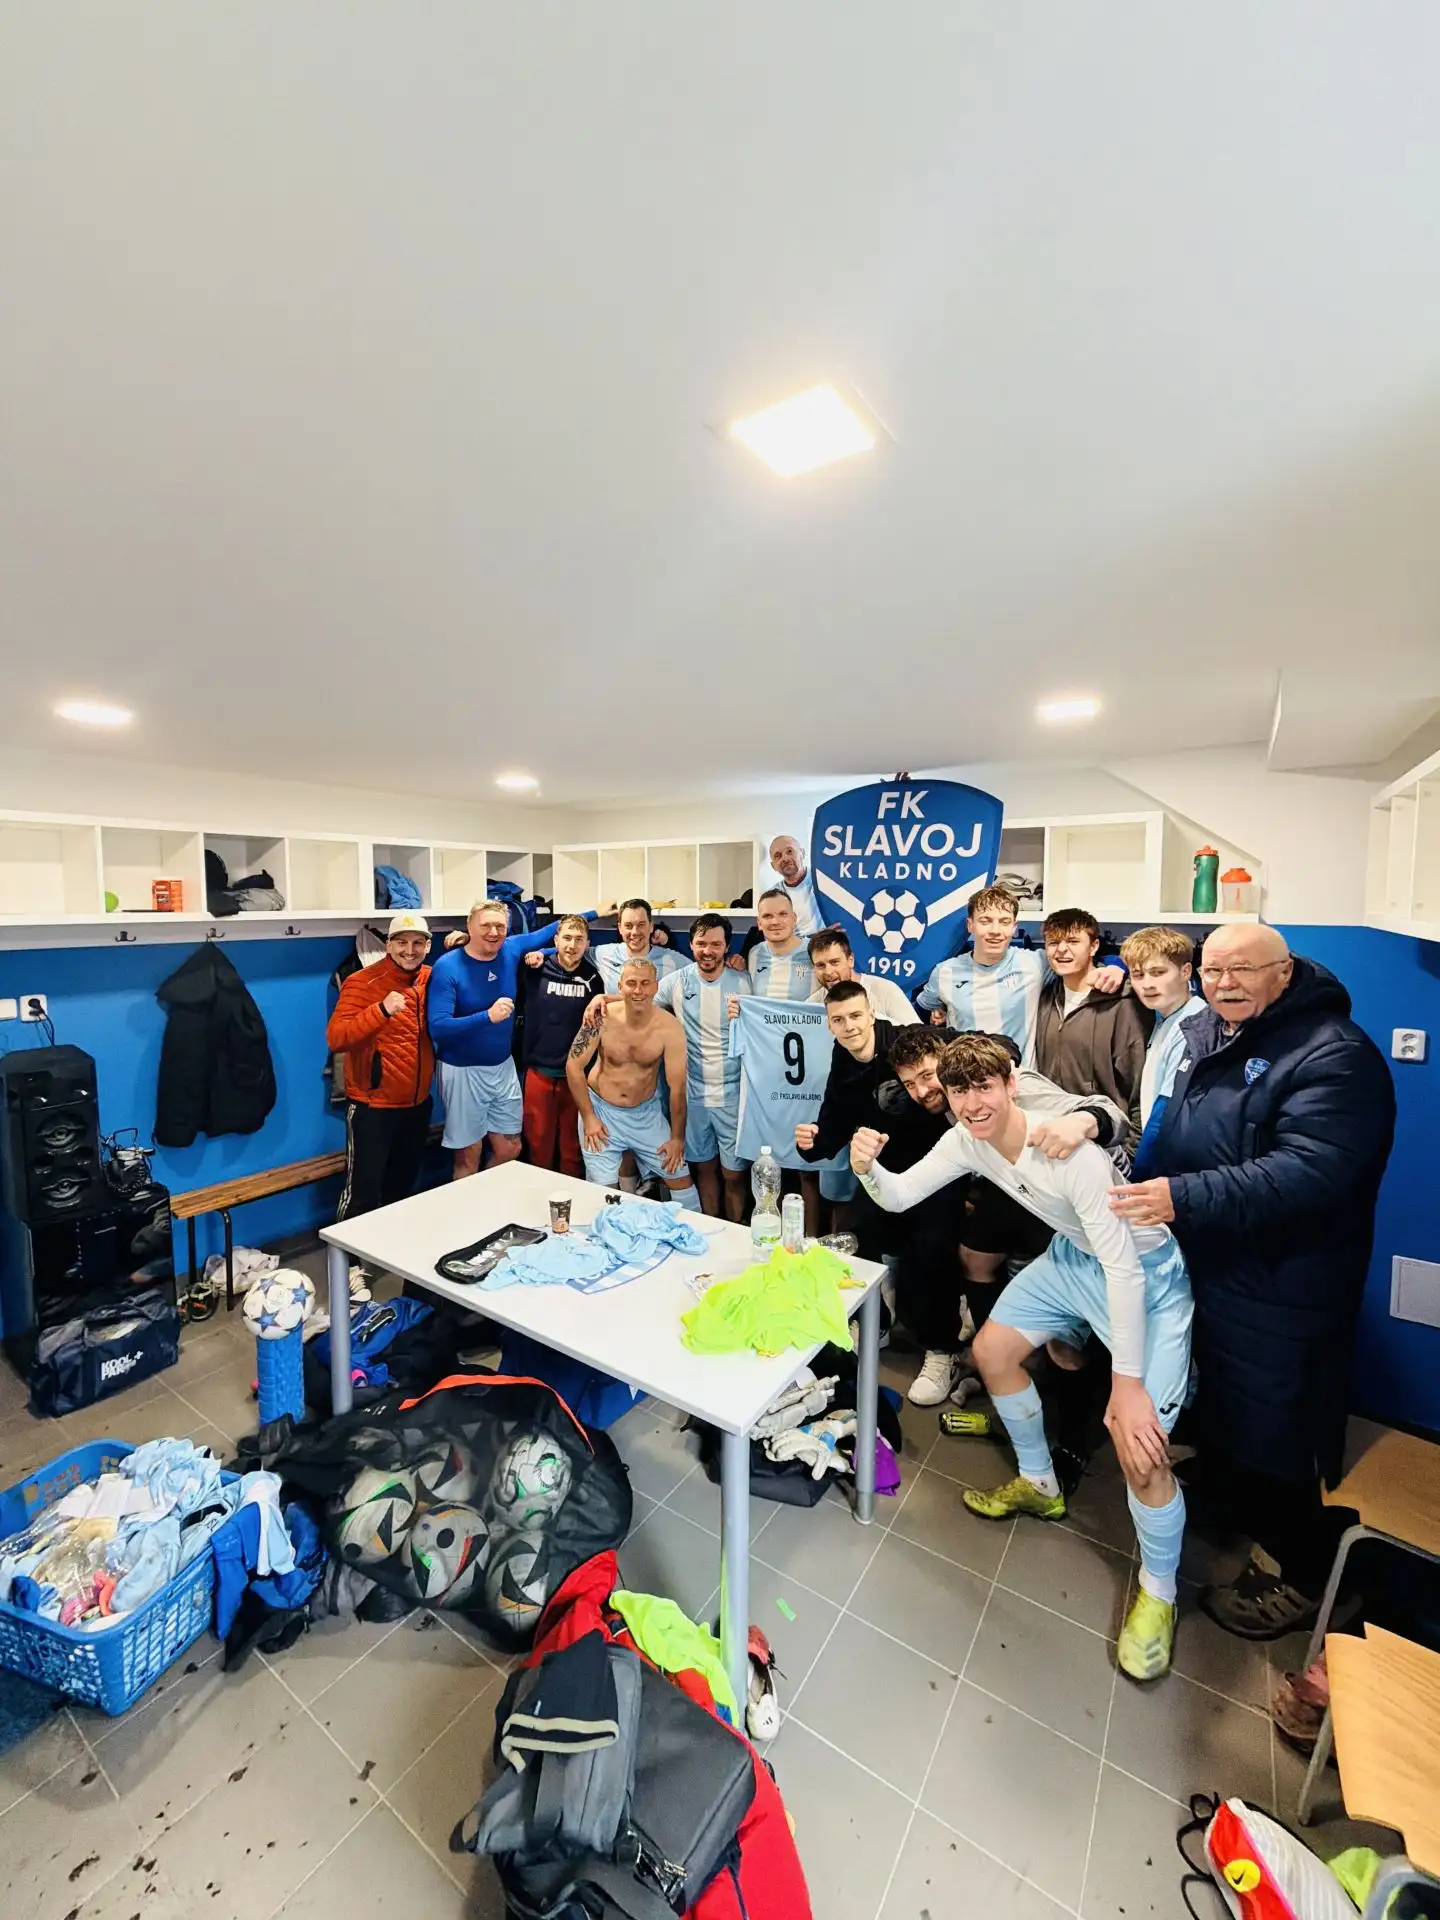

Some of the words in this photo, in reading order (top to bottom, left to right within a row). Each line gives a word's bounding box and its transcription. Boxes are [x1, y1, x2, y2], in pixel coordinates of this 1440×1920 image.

[877, 790, 928, 819] FK
[823, 823, 983, 857] SLAVOJ
[839, 862, 957, 881] KLADNO
[868, 956, 916, 977] 1919
[546, 981, 585, 997] PUMA
[764, 1014, 790, 1025] SLAVOJ
[792, 1015, 822, 1025] KLADNO
[783, 1032, 805, 1085] 9
[101, 1353, 133, 1372] KOOL
